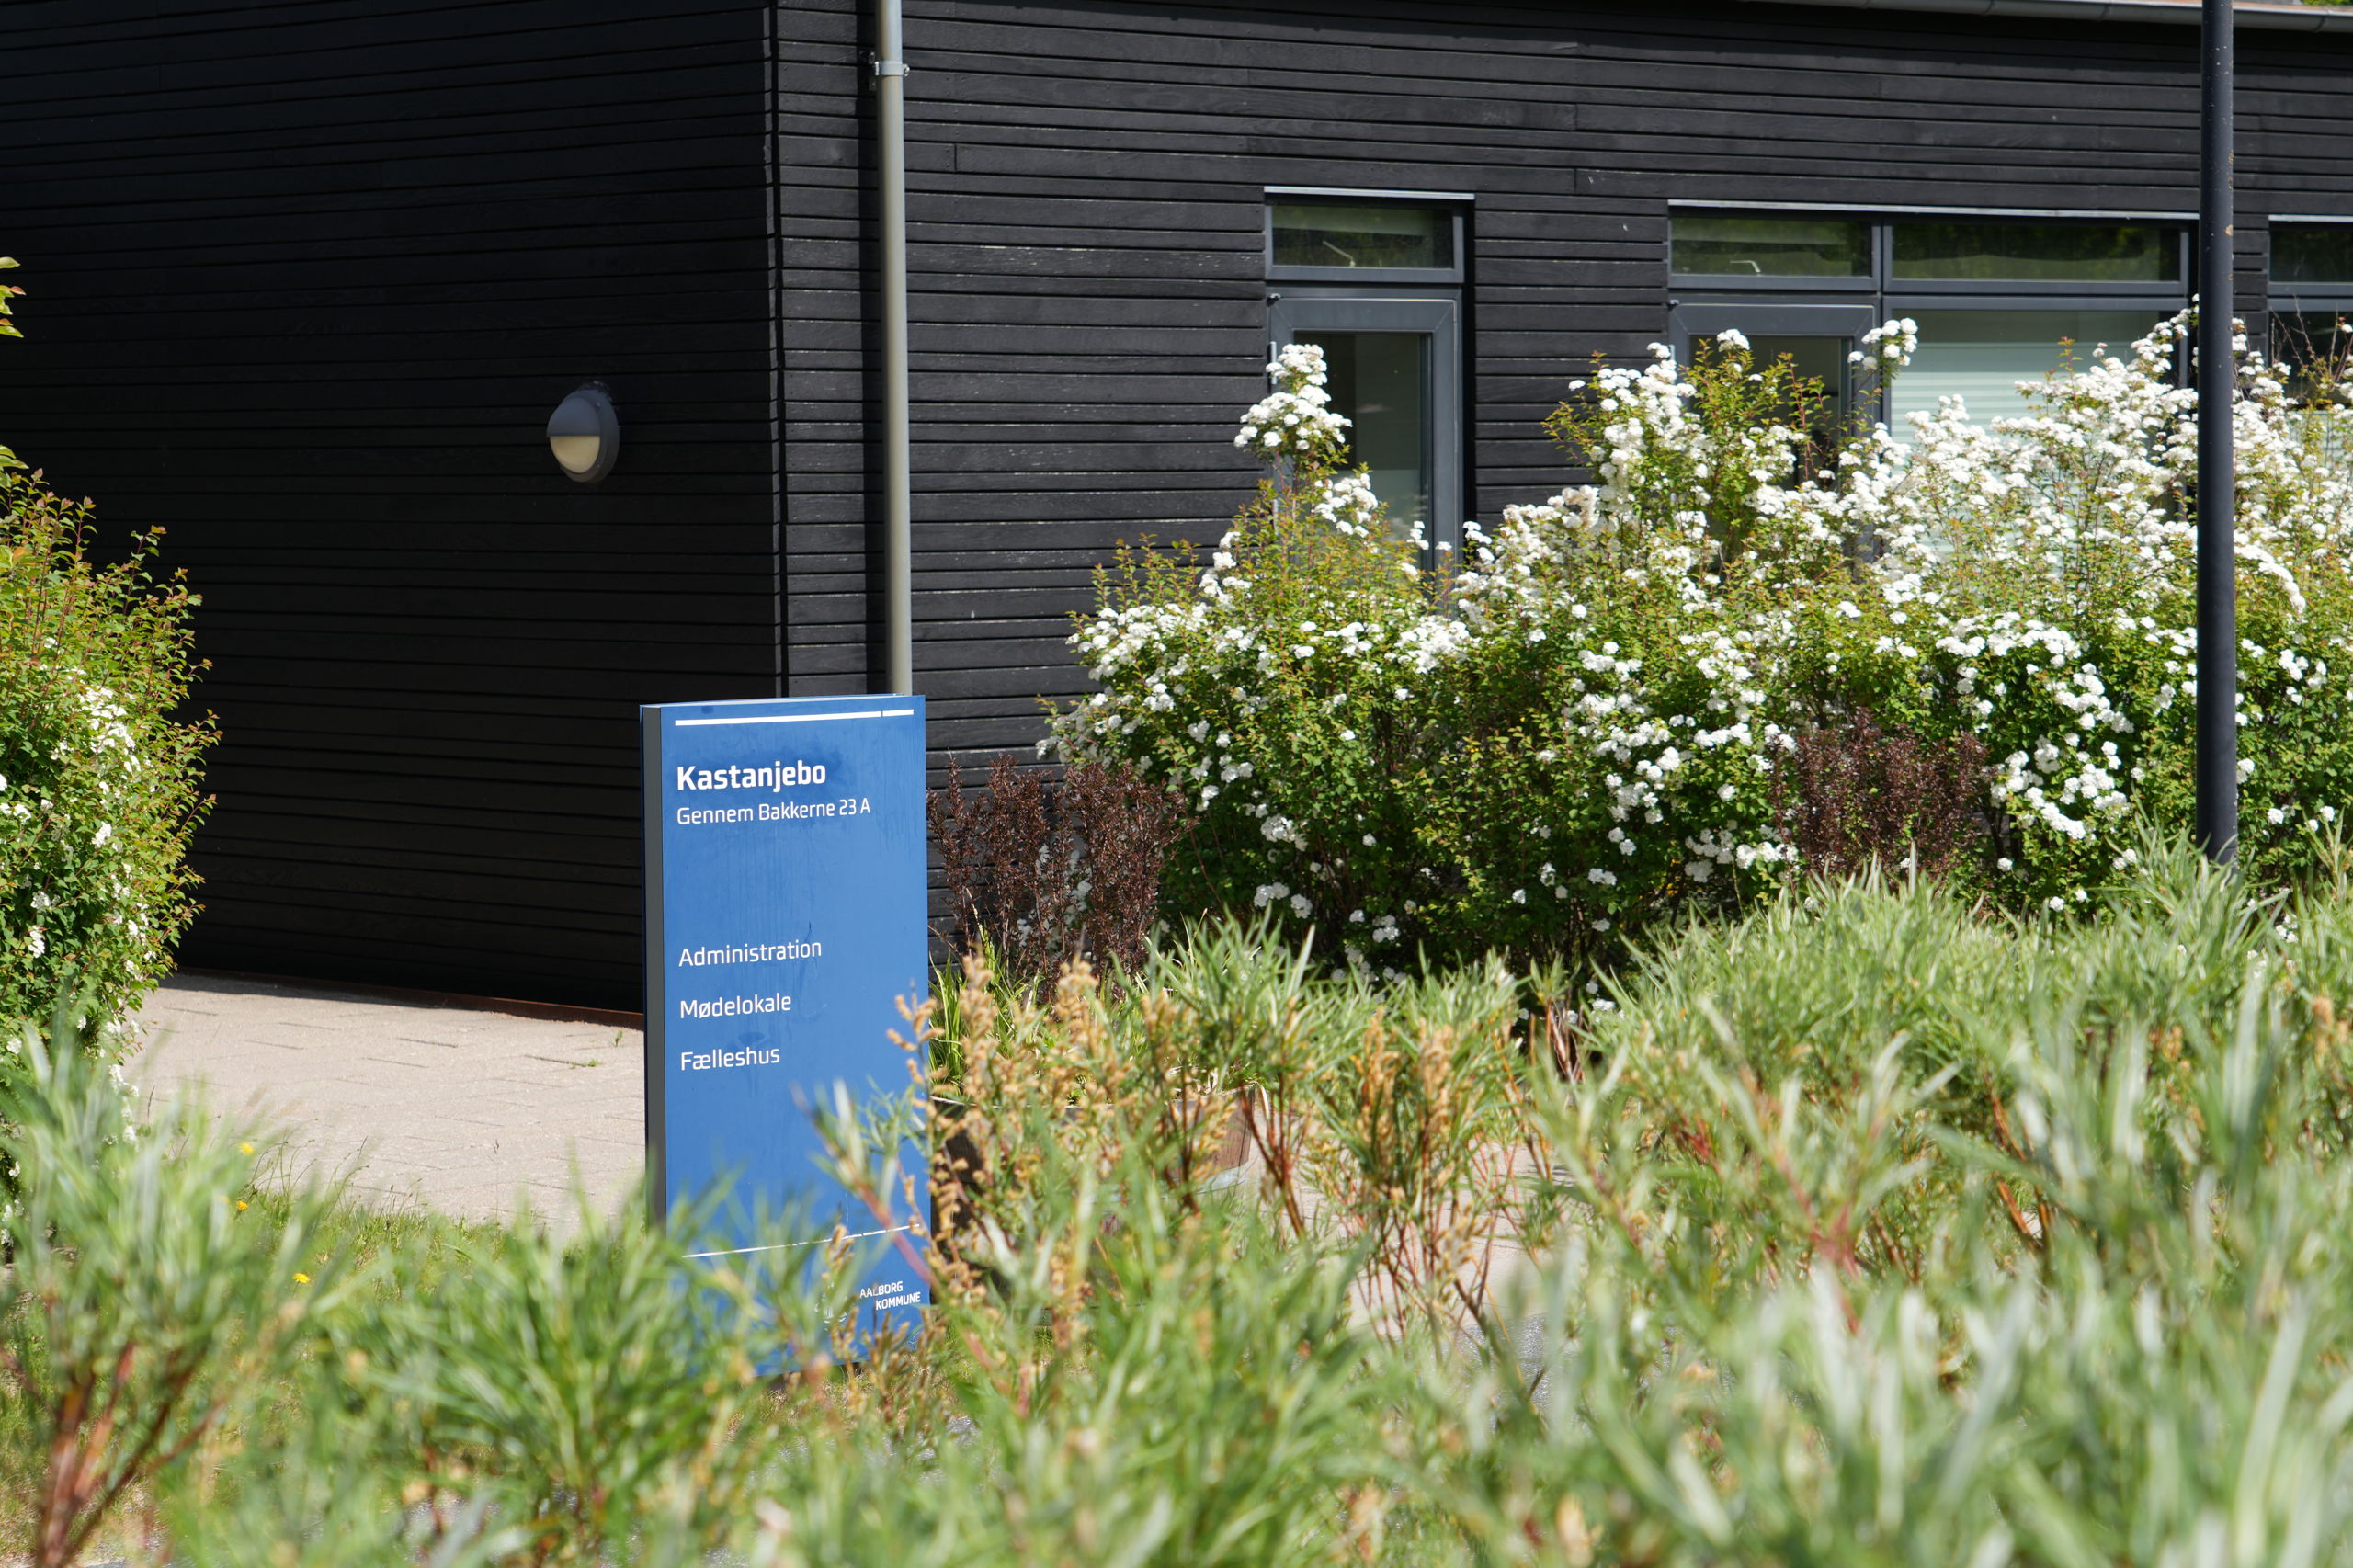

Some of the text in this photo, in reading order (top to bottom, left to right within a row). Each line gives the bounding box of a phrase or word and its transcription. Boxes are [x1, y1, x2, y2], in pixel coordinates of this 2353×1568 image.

[677, 760, 826, 793] Kastanjebo
[677, 807, 754, 824] Gennem
[758, 801, 835, 821] Bakkerne
[839, 799, 857, 816] 23
[678, 939, 822, 967] Administration
[680, 993, 791, 1019] Mødelokale
[681, 1047, 780, 1071] Fælleshus
[860, 1281, 904, 1298] AALBORG
[876, 1291, 921, 1311] KOMMUNE
